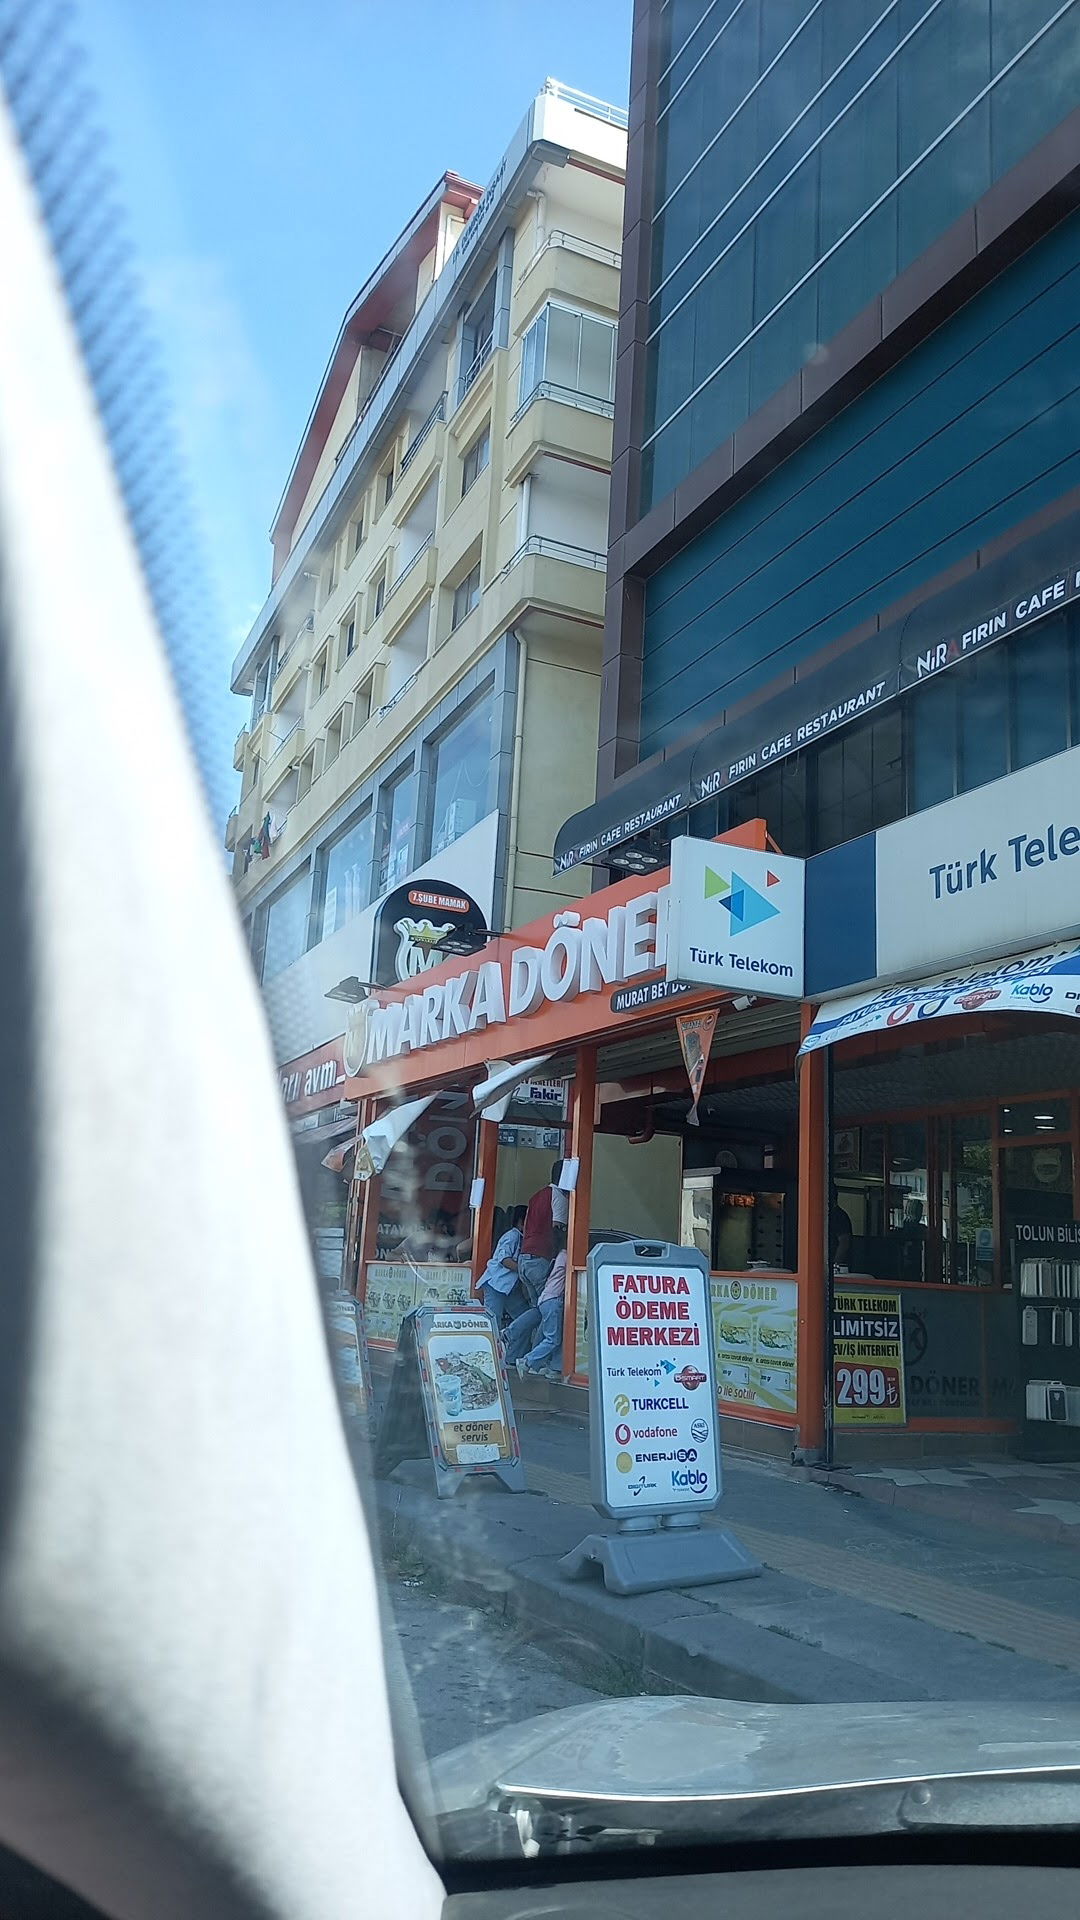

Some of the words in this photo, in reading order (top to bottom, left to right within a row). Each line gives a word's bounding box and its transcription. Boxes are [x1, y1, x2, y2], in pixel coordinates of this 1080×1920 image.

[962, 612, 1006, 649] FIRIN
[1015, 580, 1065, 619] CAFE
[729, 753, 756, 779] FIRIN
[762, 733, 792, 760] CAFE
[797, 681, 886, 741] RESTAURANT
[578, 839, 598, 858] FIRIN
[600, 826, 621, 845] CAFE
[624, 794, 682, 833] RESTAURANT
[929, 849, 997, 899] Türk
[438, 896, 467, 910] MAMAK
[689, 947, 724, 968] Türk
[729, 952, 794, 978] Telekom
[616, 987, 649, 1010] MURAT
[651, 983, 669, 1000] BEY
[1011, 983, 1054, 998] Kablo
[367, 961, 507, 1065] MARKA
[304, 1060, 337, 1096] avm
[530, 1087, 562, 1101] Fakir
[1016, 1224, 1054, 1242] TOLUN
[613, 1274, 690, 1295] FATURA
[743, 1283, 778, 1301] DÖNER
[615, 1296, 690, 1320] ÖDEME
[858, 1299, 897, 1313] TELEKOM
[461, 1319, 489, 1329] DÖNER
[833, 1316, 898, 1338] LİMİTSİZ
[607, 1322, 700, 1346] MERKEZİ
[857, 1342, 899, 1357] İNTERNETİ
[607, 1367, 626, 1377] Türk
[627, 1367, 662, 1378] Telekom
[836, 1369, 886, 1405] 299
[632, 1398, 689, 1410] TURKCELL
[453, 1423, 463, 1433] et
[466, 1422, 493, 1433] döner
[633, 1426, 678, 1438] vodafone
[461, 1432, 489, 1442] servis
[671, 1469, 708, 1487] Kablo
